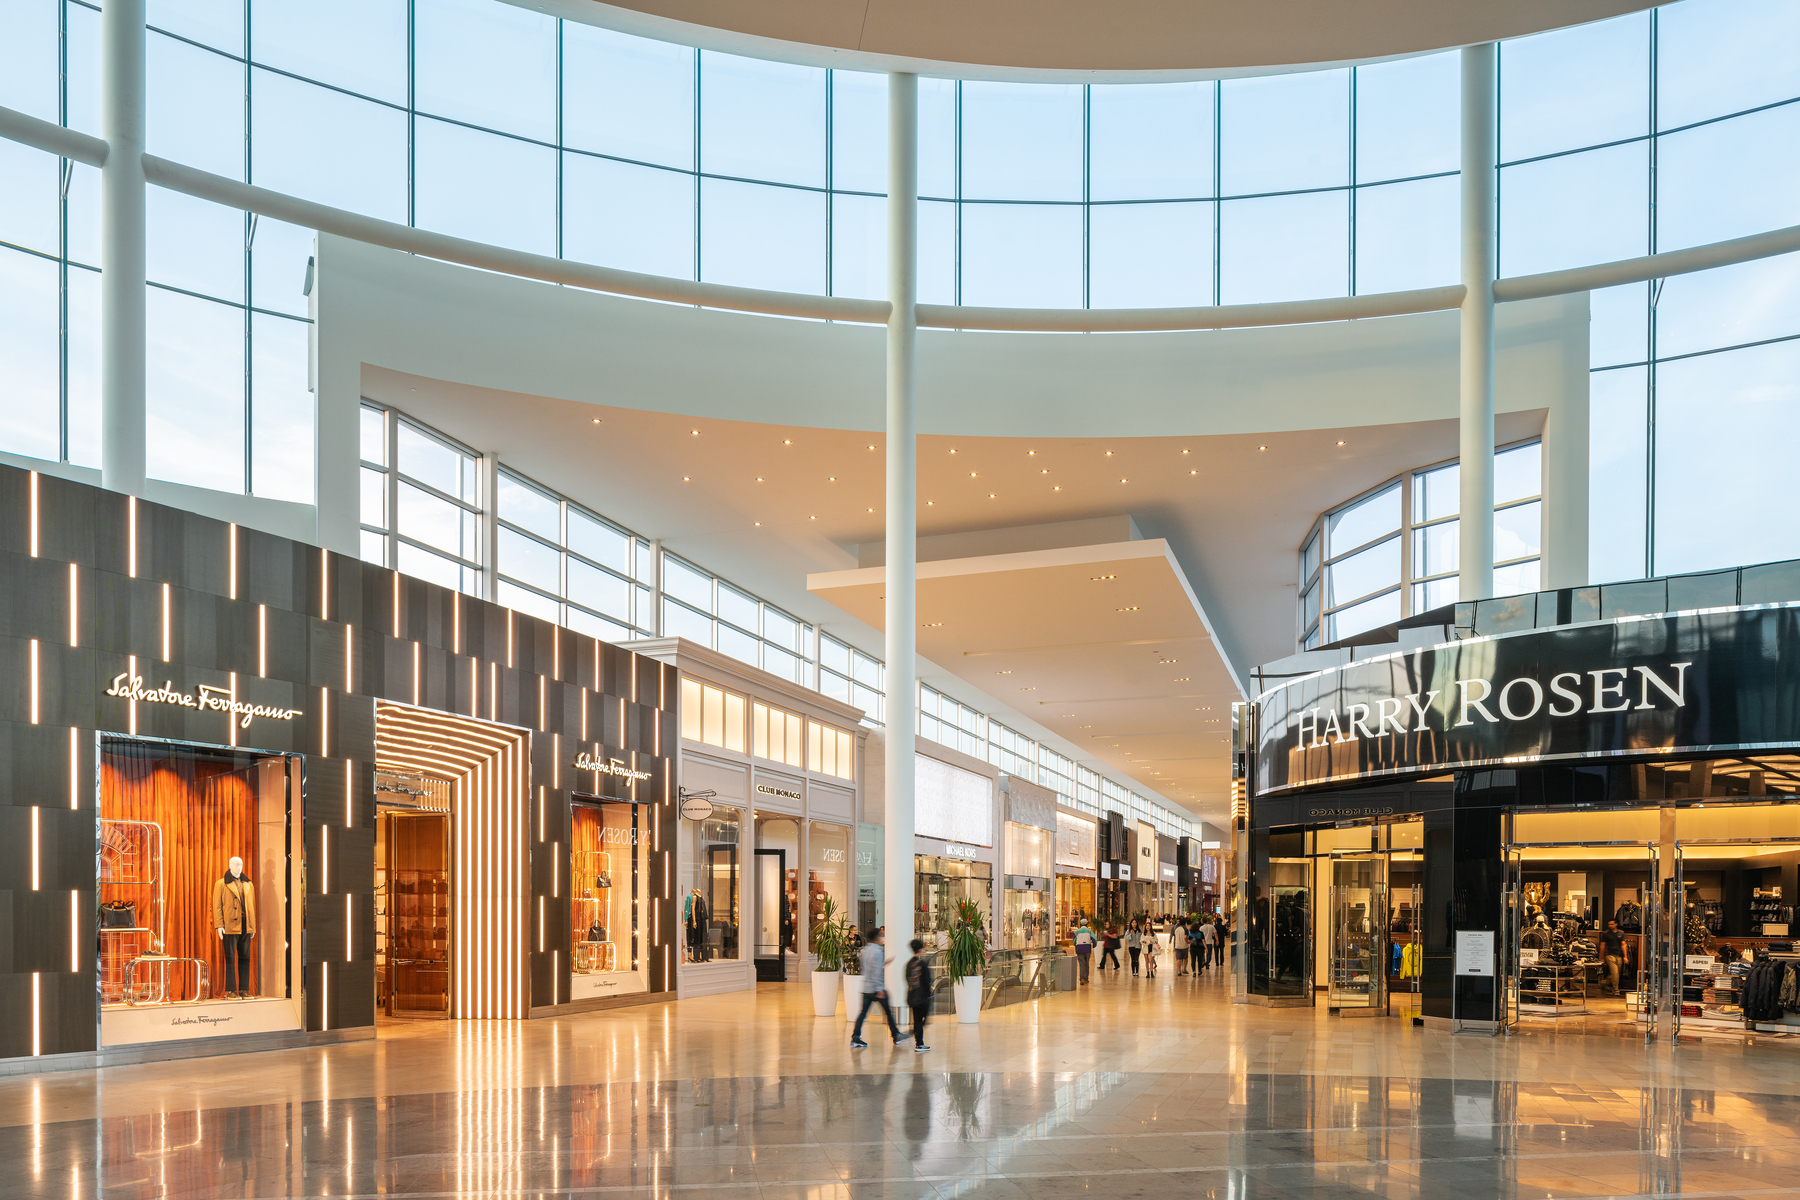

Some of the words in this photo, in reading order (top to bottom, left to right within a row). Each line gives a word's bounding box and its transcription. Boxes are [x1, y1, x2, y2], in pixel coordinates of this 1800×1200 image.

[106, 672, 197, 707] Salvatore
[198, 684, 304, 729] Ferragamo
[1296, 690, 1441, 752] HARRY
[1454, 662, 1692, 727] ROSEN
[575, 752, 611, 773] Salvatore
[610, 757, 652, 787] Ferragamo
[757, 785, 775, 796] CLUB
[775, 788, 801, 801] MONACO
[945, 844, 965, 857] MICHAEL
[965, 847, 977, 858] KORS
[171, 1016, 198, 1026] Salvatore
[198, 1015, 233, 1027] Ferragamo
